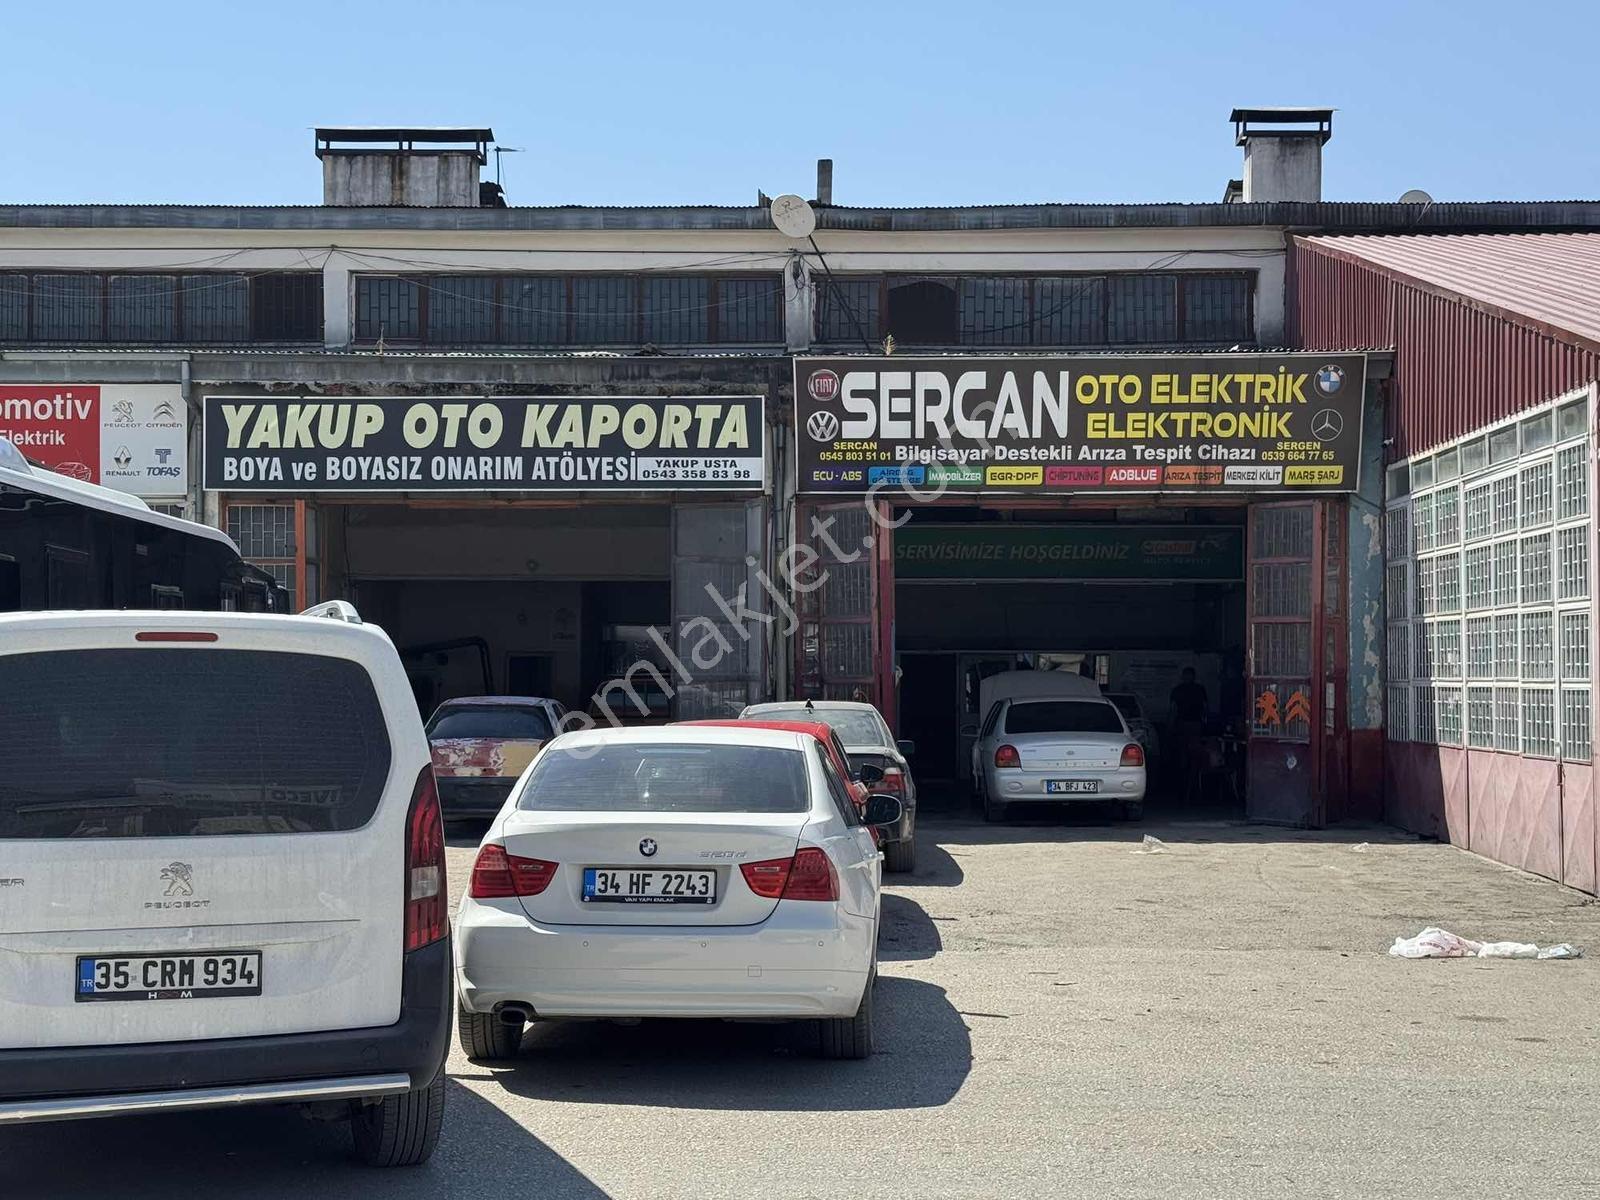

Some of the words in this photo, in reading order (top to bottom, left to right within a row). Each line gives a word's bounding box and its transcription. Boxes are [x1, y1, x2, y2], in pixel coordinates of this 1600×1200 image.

[815, 378, 833, 394] FIAT
[1075, 375, 1142, 404] OTO
[1150, 366, 1309, 404] ELEKTRİK
[0, 393, 92, 420] motiv
[841, 371, 1069, 439] SERCAN
[221, 404, 385, 449] YAKUP
[403, 403, 503, 450] OTO
[521, 403, 749, 449] KAPORTA
[1087, 405, 1293, 439] ELEKTRONİK
[833, 441, 877, 450] SERCAN
[1276, 441, 1321, 450] SERGEN
[820, 451, 843, 461] 0545
[845, 451, 863, 461] 803
[866, 451, 877, 461] 51
[880, 451, 891, 461] 01
[895, 445, 988, 464] Bilgisayar
[995, 445, 1072, 461] Destekli
[1078, 446, 1126, 461] Arıza
[1133, 444, 1191, 465] Tespit
[1197, 445, 1256, 461] Cihazı
[1261, 451, 1285, 461] 0539
[1287, 451, 1305, 461] 664
[1308, 451, 1320, 460] 77
[1322, 451, 1335, 460] 65
[223, 456, 284, 481] BOYA
[291, 461, 317, 481] ve
[326, 455, 422, 481] BOYASIZ
[431, 456, 523, 481] ONARIM
[531, 451, 636, 481] ATÖLYESİ
[655, 459, 698, 468] YAKUP
[704, 459, 738, 468] USTA
[146, 466, 181, 477] TOFAŞ
[642, 469, 676, 479] 0543
[682, 469, 707, 479] 358
[712, 469, 729, 479] 83
[734, 469, 751, 479] 98
[813, 471, 834, 481] ECU
[841, 471, 862, 481] ABS
[1110, 469, 1157, 481] ADBLUE
[1166, 472, 1191, 480] ARIZA
[1226, 470, 1257, 480] MERKEZİ
[1260, 469, 1280, 480] KİLİT
[1288, 470, 1315, 483] MARŞ
[1317, 470, 1340, 483] ŞARJ
[896, 541, 1005, 560] SERVİSİMİZE
[1009, 541, 1130, 562] HOŞGELDİNİZ
[1052, 782, 1062, 791] 34
[1065, 782, 1079, 791] BFJ
[1082, 782, 1096, 791] 423
[597, 872, 621, 894] 34
[629, 873, 653, 895] HF
[661, 874, 709, 896] 2243
[144, 900, 211, 908] PEUGEOT
[96, 961, 129, 989] 35
[142, 958, 195, 988] CRM
[203, 957, 254, 986] 934
[82, 979, 93, 988] TR
